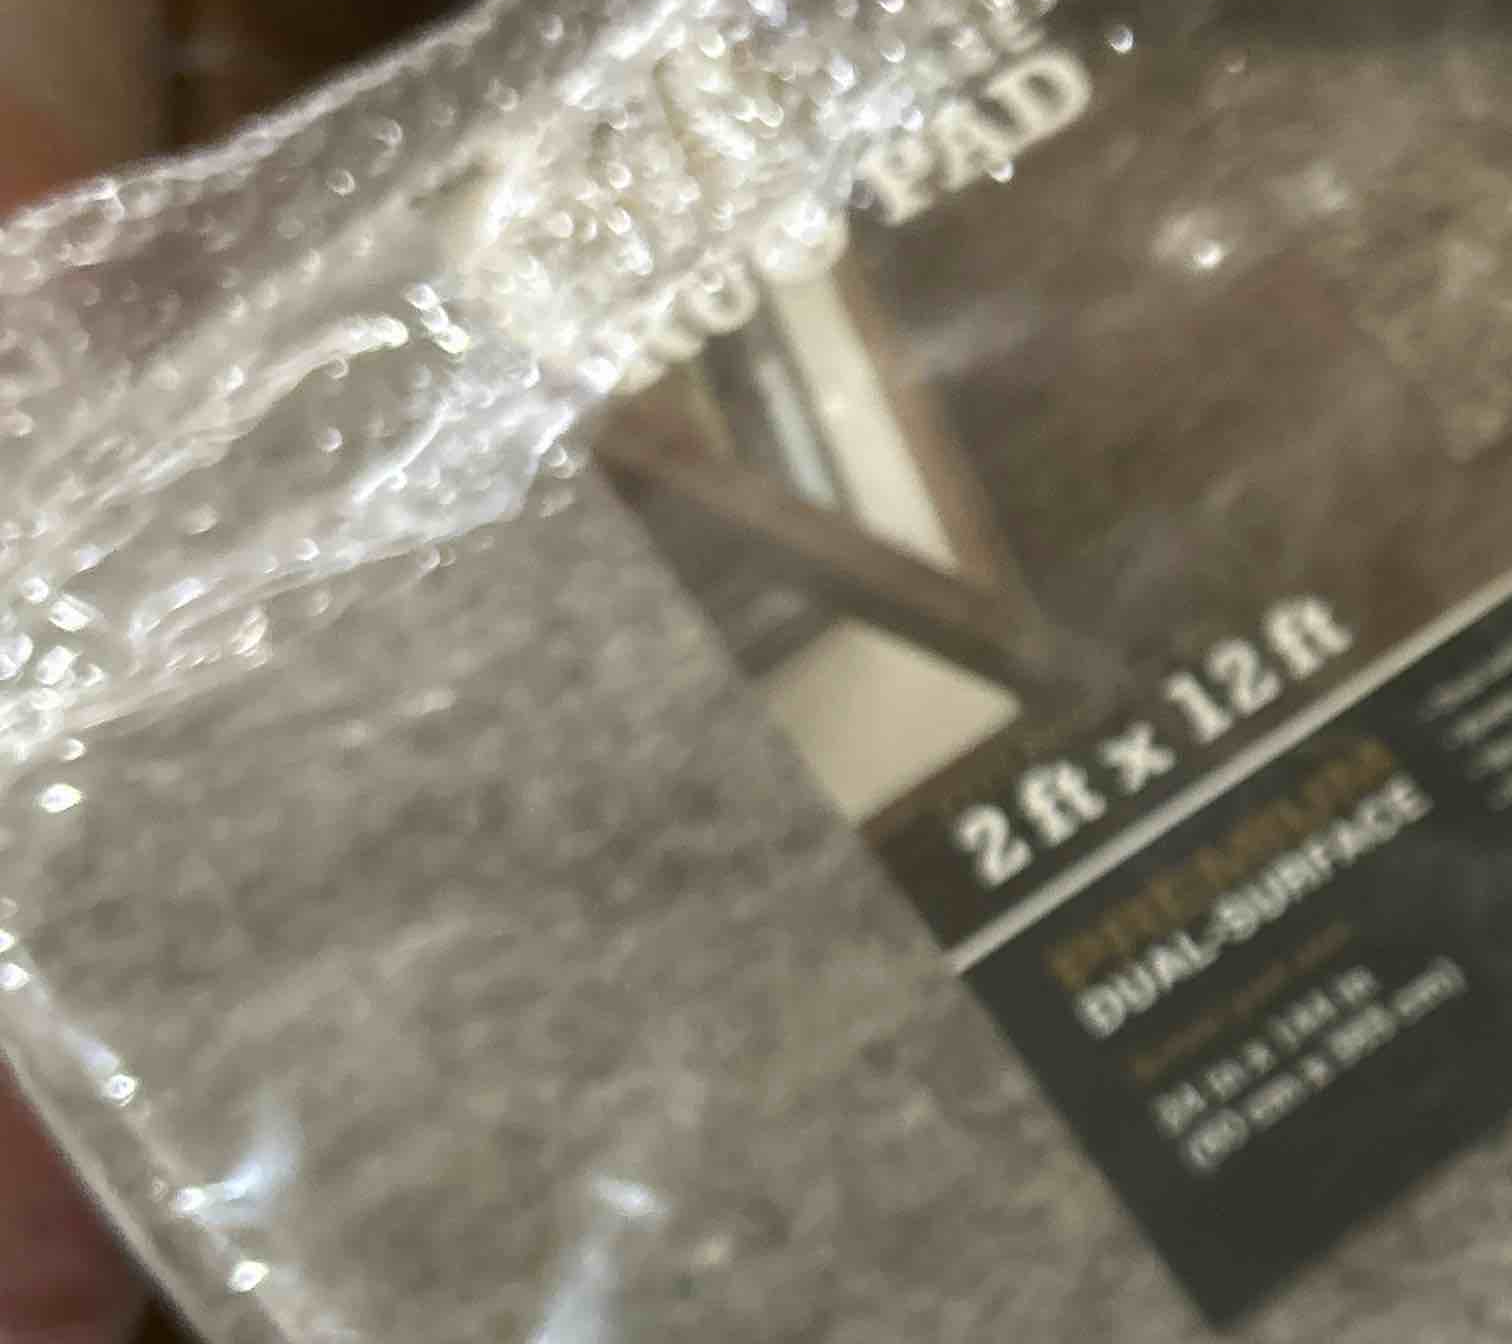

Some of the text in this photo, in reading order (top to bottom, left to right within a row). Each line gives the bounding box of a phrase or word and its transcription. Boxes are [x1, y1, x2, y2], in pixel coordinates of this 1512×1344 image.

[855, 50, 1093, 225] PAD
[953, 592, 1353, 887] 2 ft x 12 ft
[1075, 772, 1434, 1039] DUAL-SURFACE
